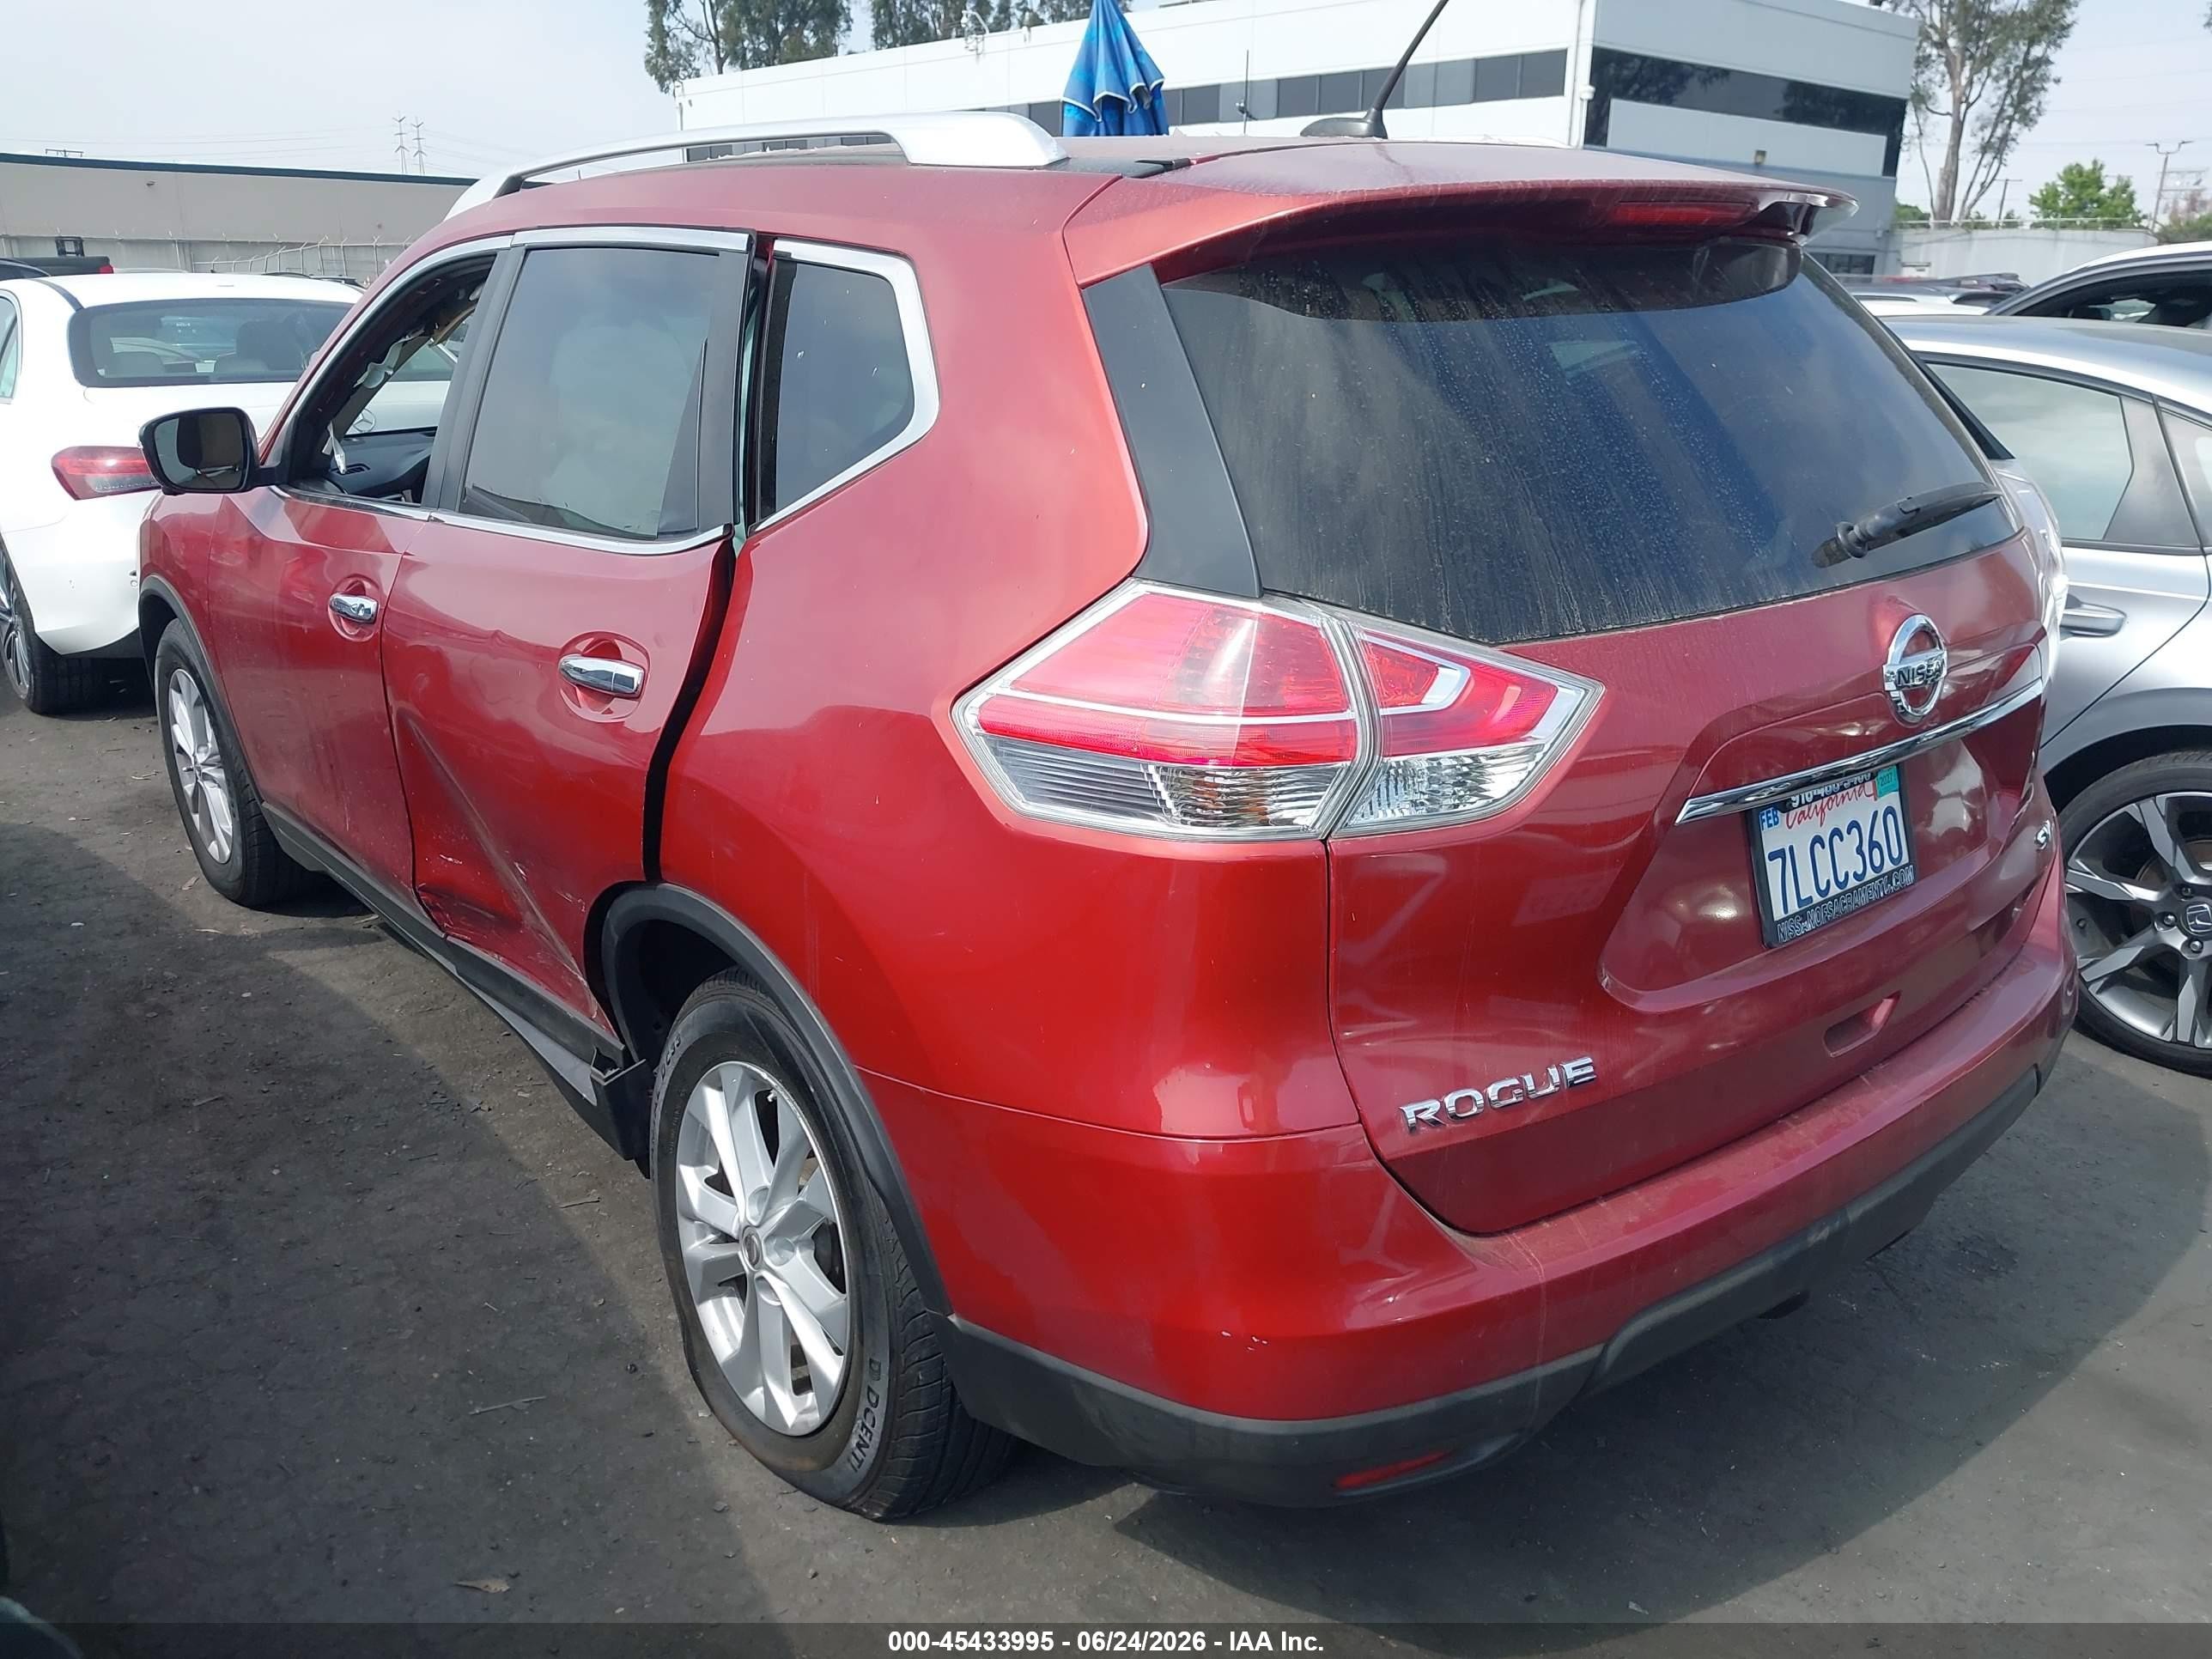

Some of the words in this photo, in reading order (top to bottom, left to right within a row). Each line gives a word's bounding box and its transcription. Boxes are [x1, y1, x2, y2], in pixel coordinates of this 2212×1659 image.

[1759, 810, 1779, 831] FEB
[1767, 805, 1903, 915] 7LCC360
[1399, 1056, 1596, 1133] ROGUE
